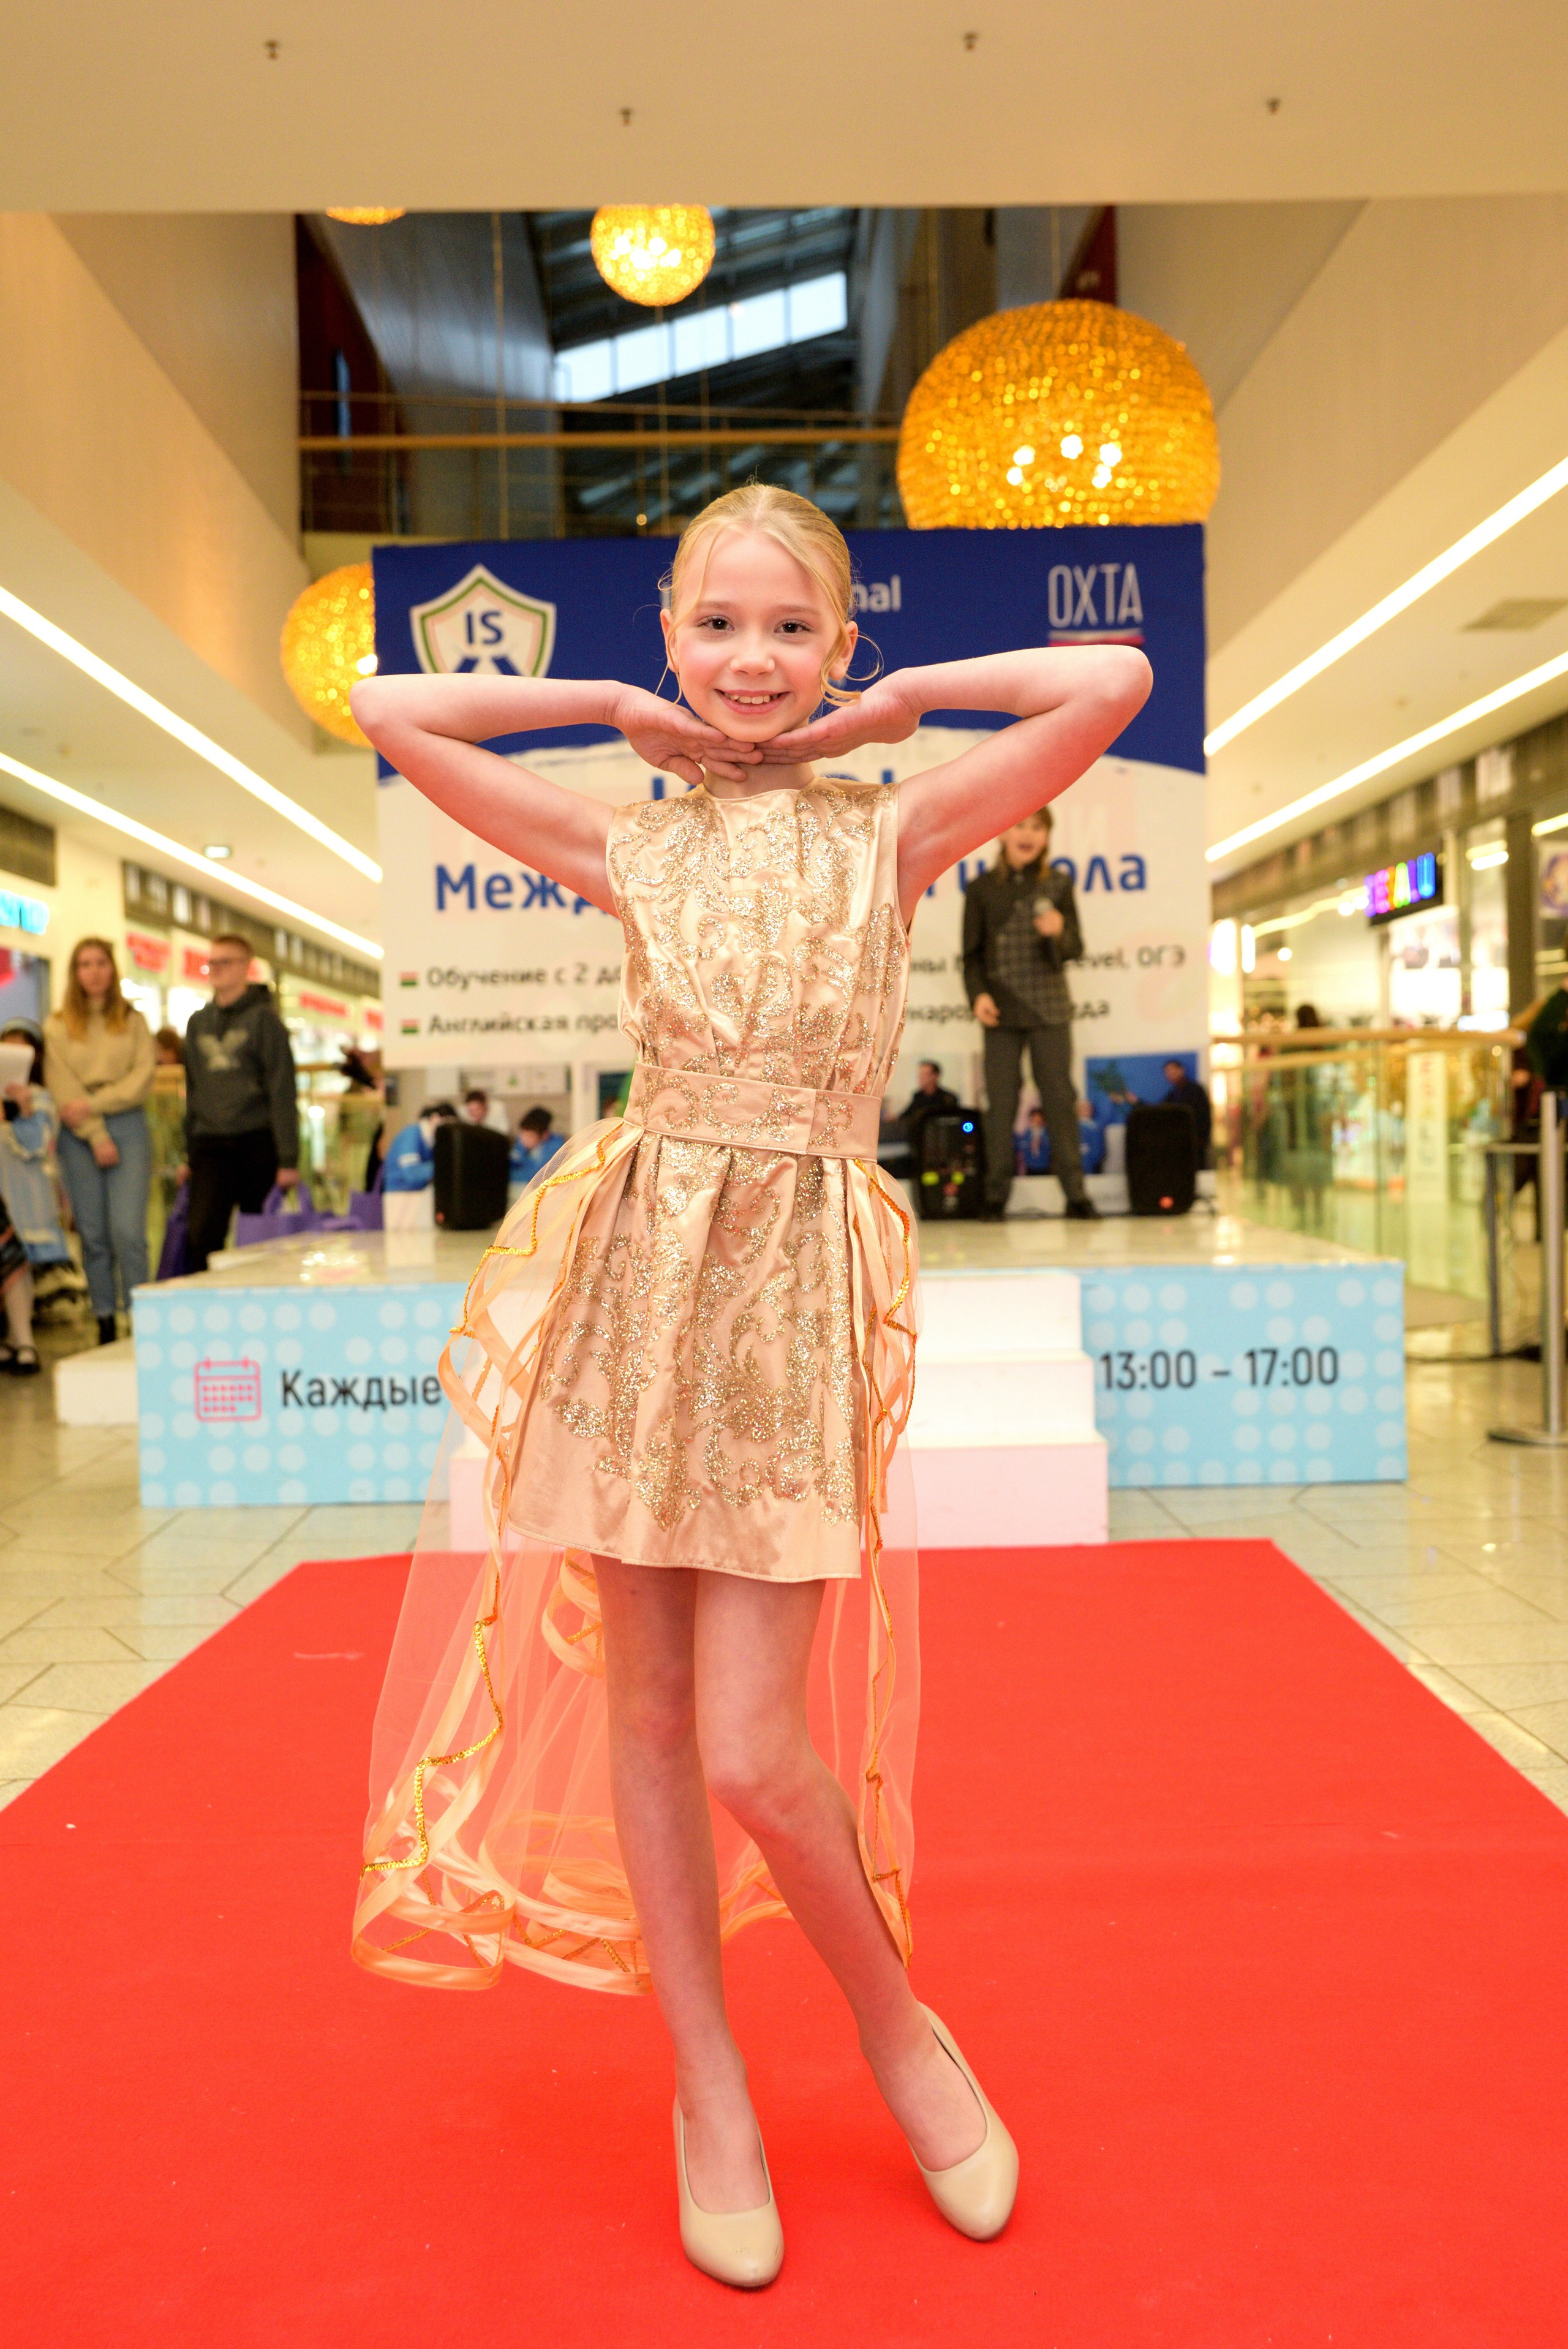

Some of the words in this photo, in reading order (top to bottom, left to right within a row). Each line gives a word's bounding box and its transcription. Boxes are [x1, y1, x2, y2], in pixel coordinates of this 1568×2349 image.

[848, 574, 901, 612] nal
[1048, 563, 1144, 628] ОХТА
[467, 611, 502, 645] IS
[435, 864, 606, 914] Меж
[428, 966, 546, 989] Обучение
[554, 968, 565, 983] с
[575, 962, 588, 983] 2
[1137, 946, 1186, 967] ОГЭ
[429, 1013, 568, 1034] Английская
[576, 1015, 618, 1034] про
[281, 1370, 442, 1411] Каждые
[1100, 1349, 1197, 1390] 13:00
[1246, 1346, 1340, 1386] 17:00
